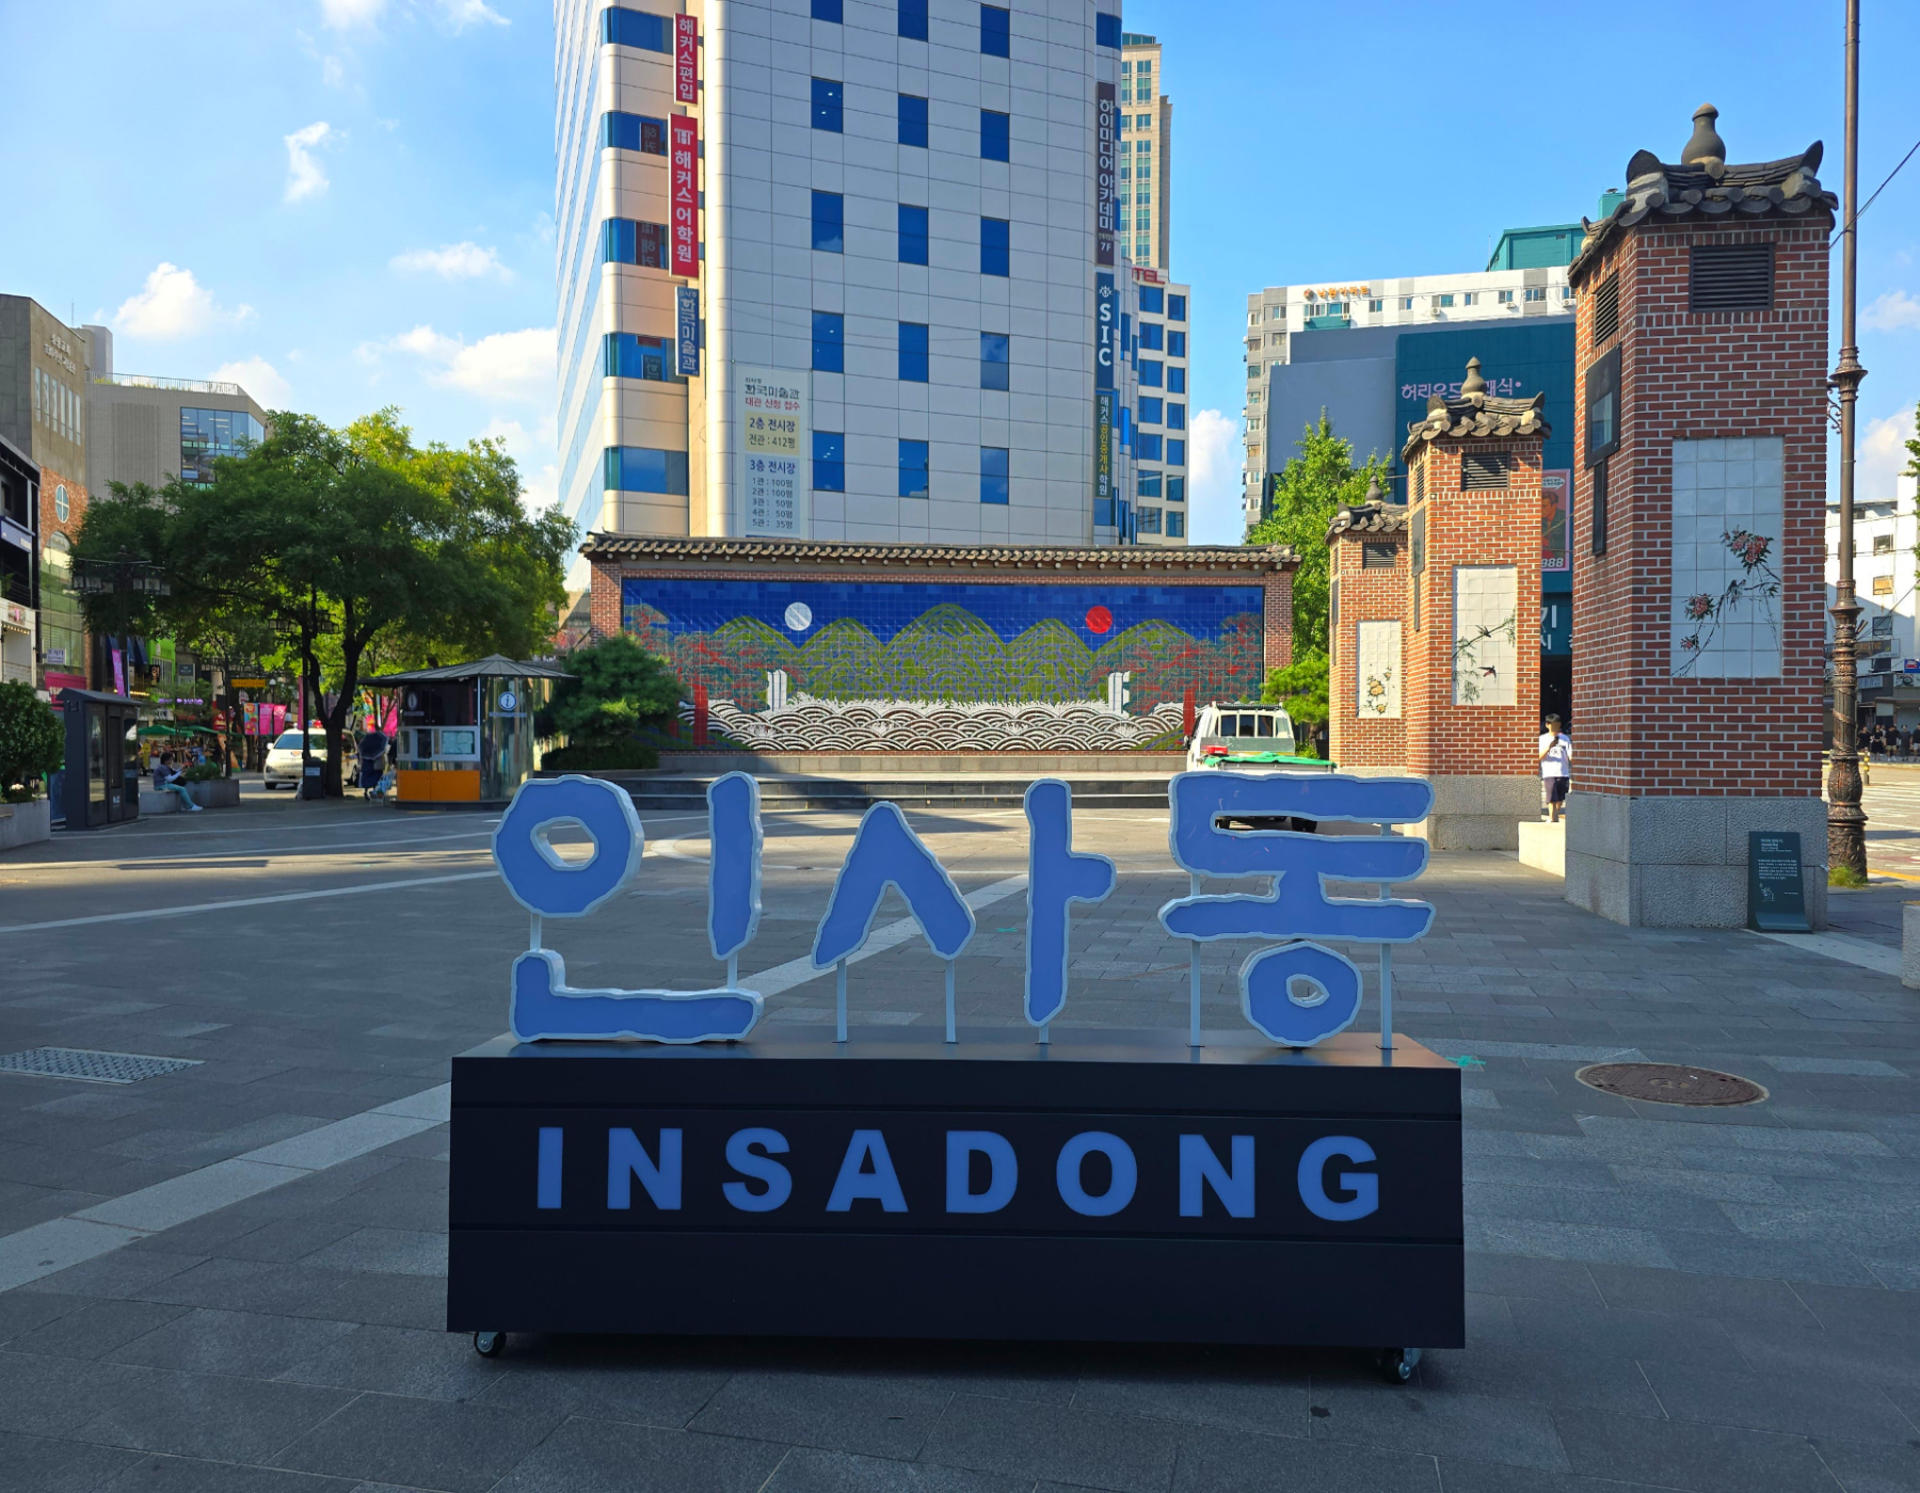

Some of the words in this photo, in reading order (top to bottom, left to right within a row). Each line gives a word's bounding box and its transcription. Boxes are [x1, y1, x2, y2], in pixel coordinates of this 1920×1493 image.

[680, 18, 694, 100] 해커스편입
[1099, 99, 1113, 171] 하이미디어
[674, 150, 693, 263] 해커스어학원
[1099, 174, 1113, 231] 아카데미
[1100, 242, 1112, 252] 7F
[680, 298, 697, 371] 한국미술관
[1098, 303, 1112, 366] SIC
[749, 416, 765, 431] 2층
[767, 418, 796, 433] 전시장
[749, 459, 765, 473] 3층
[767, 460, 796, 475] 전시장
[1541, 557, 1564, 568] 988
[492, 771, 1437, 1049] 인사동
[536, 1126, 1381, 1222] INSADONG
